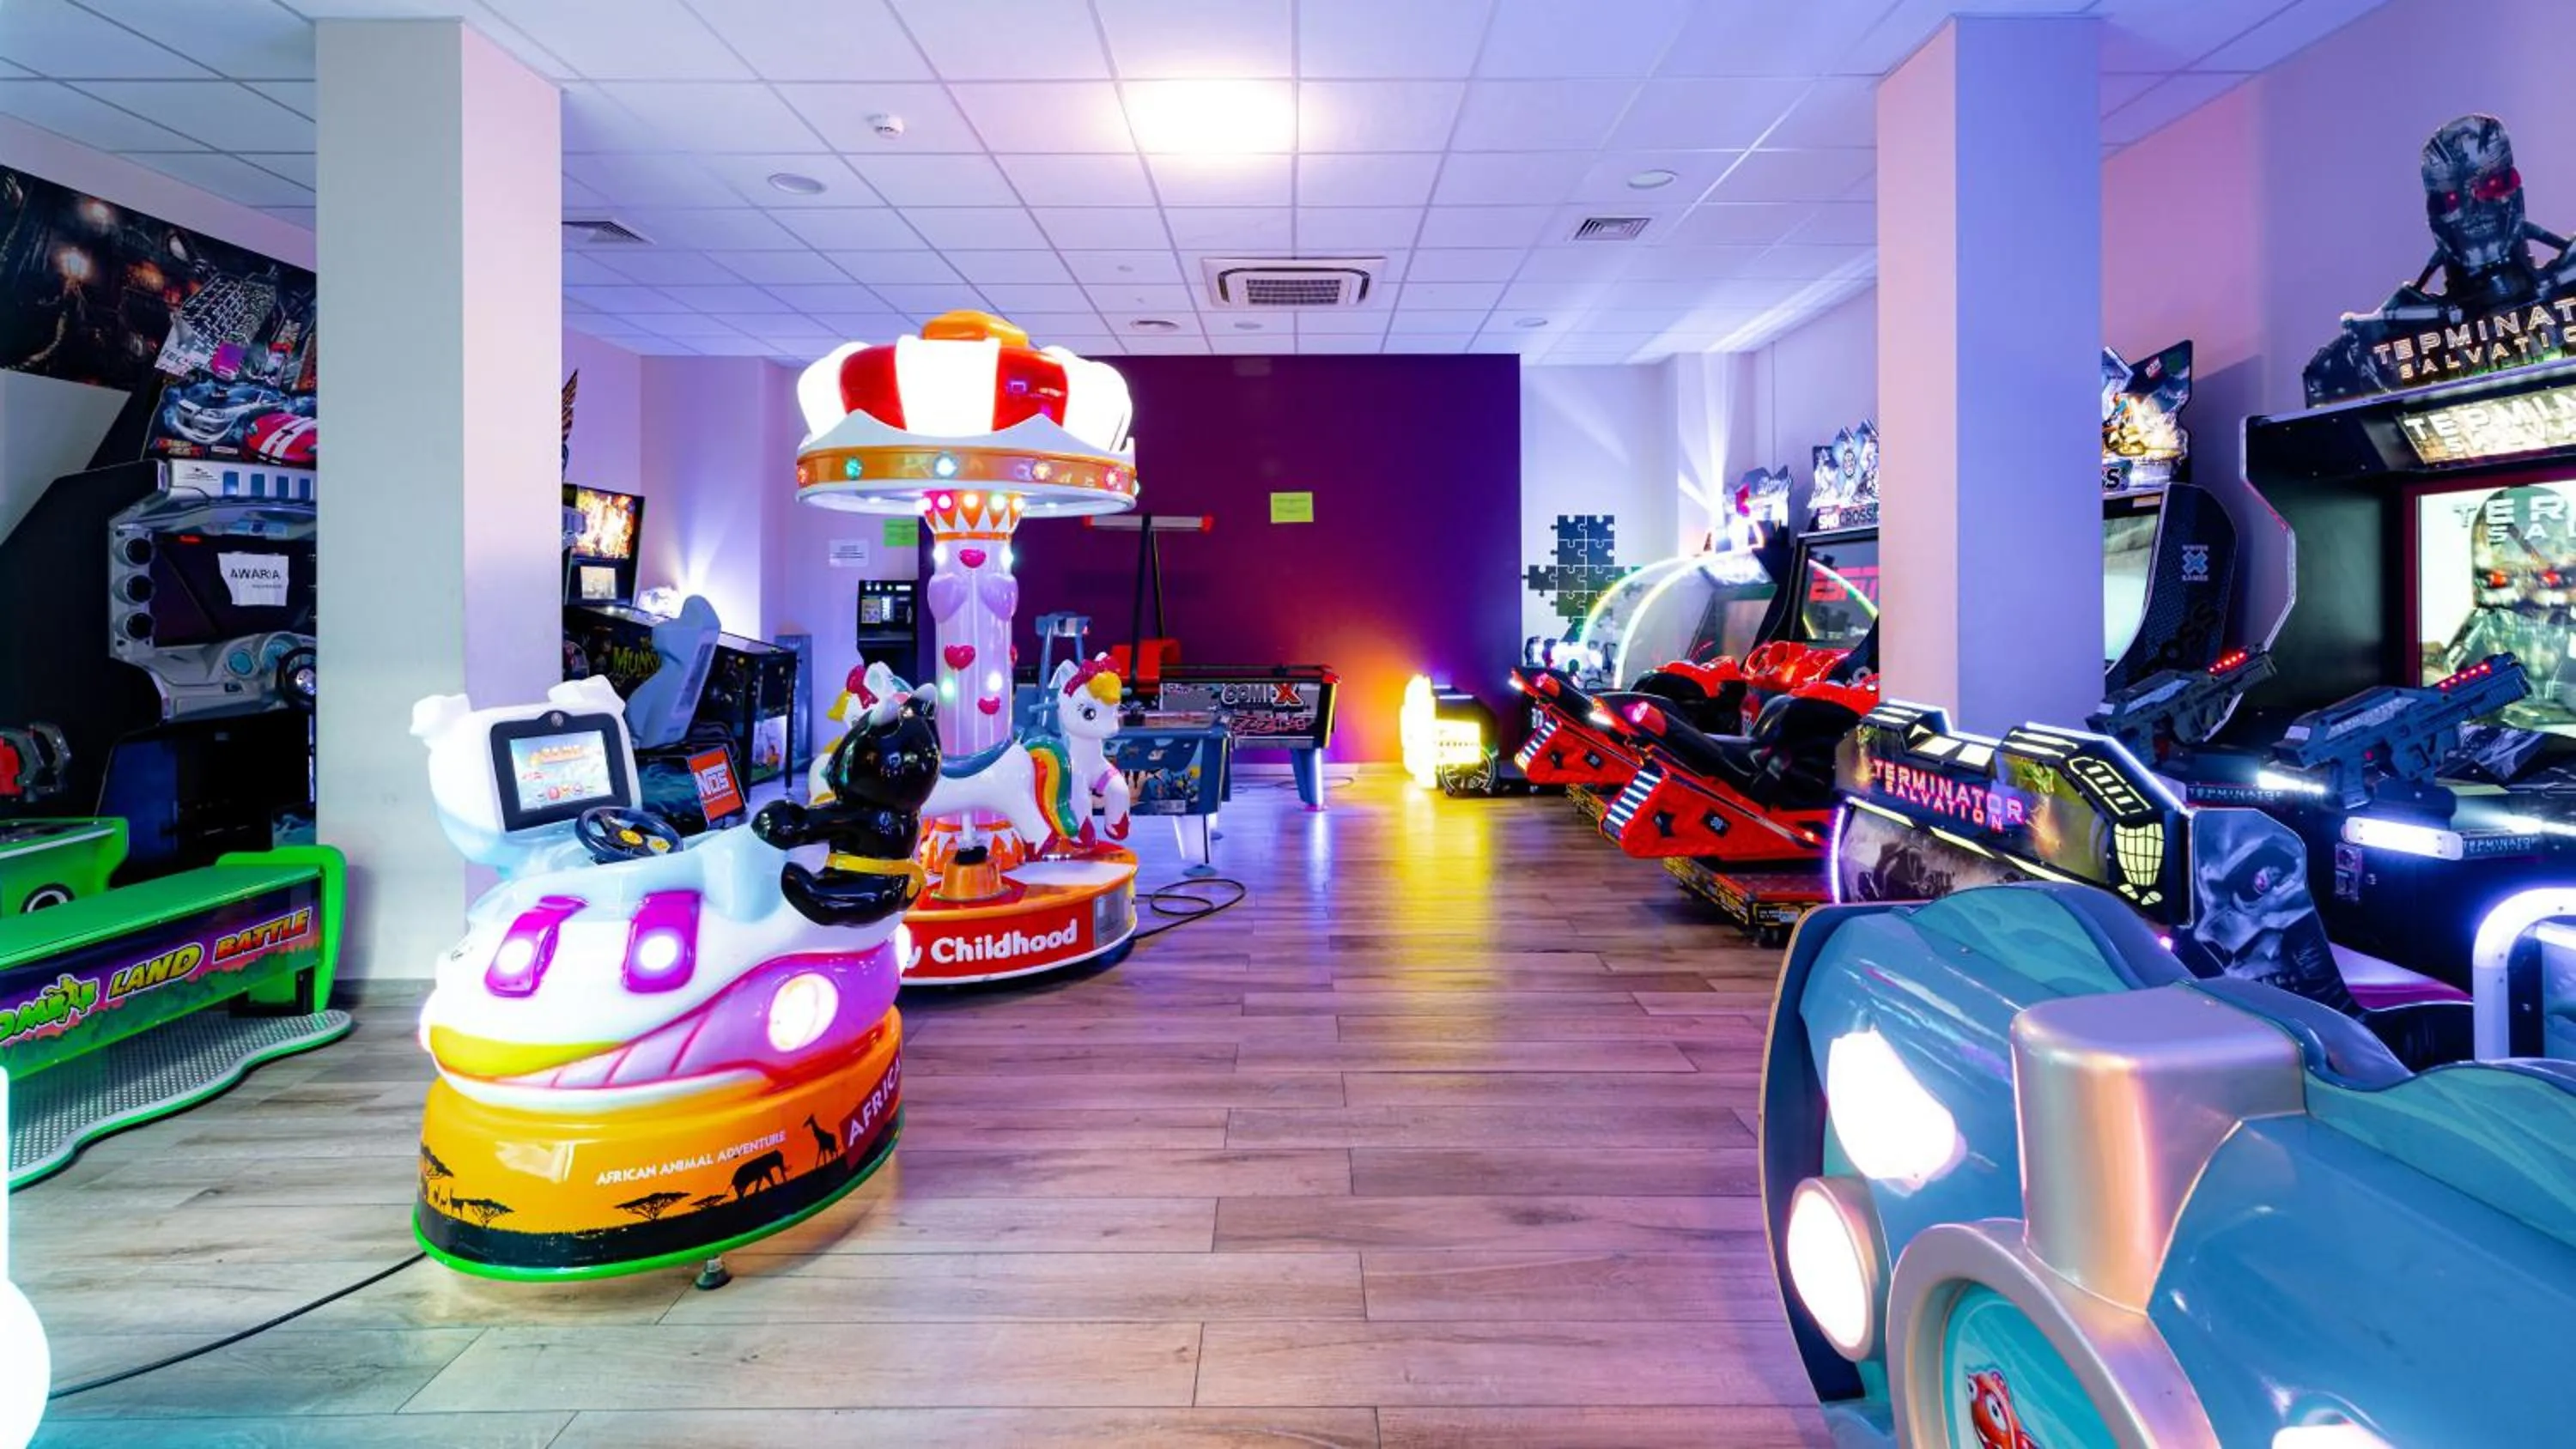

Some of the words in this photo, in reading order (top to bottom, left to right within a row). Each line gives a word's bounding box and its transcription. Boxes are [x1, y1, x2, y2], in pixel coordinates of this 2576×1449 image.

[230, 567, 281, 579] AWARIA
[1871, 758, 2024, 825] TERMINATOR
[1885, 781, 2003, 833] SALVATION
[106, 944, 204, 1001] LAND
[214, 908, 312, 962] BATTLE
[931, 919, 1078, 964] Childhood
[596, 1165, 657, 1186] AFRICAN
[659, 1157, 714, 1177] ANIMAL
[718, 1130, 787, 1162] ADVENTURE
